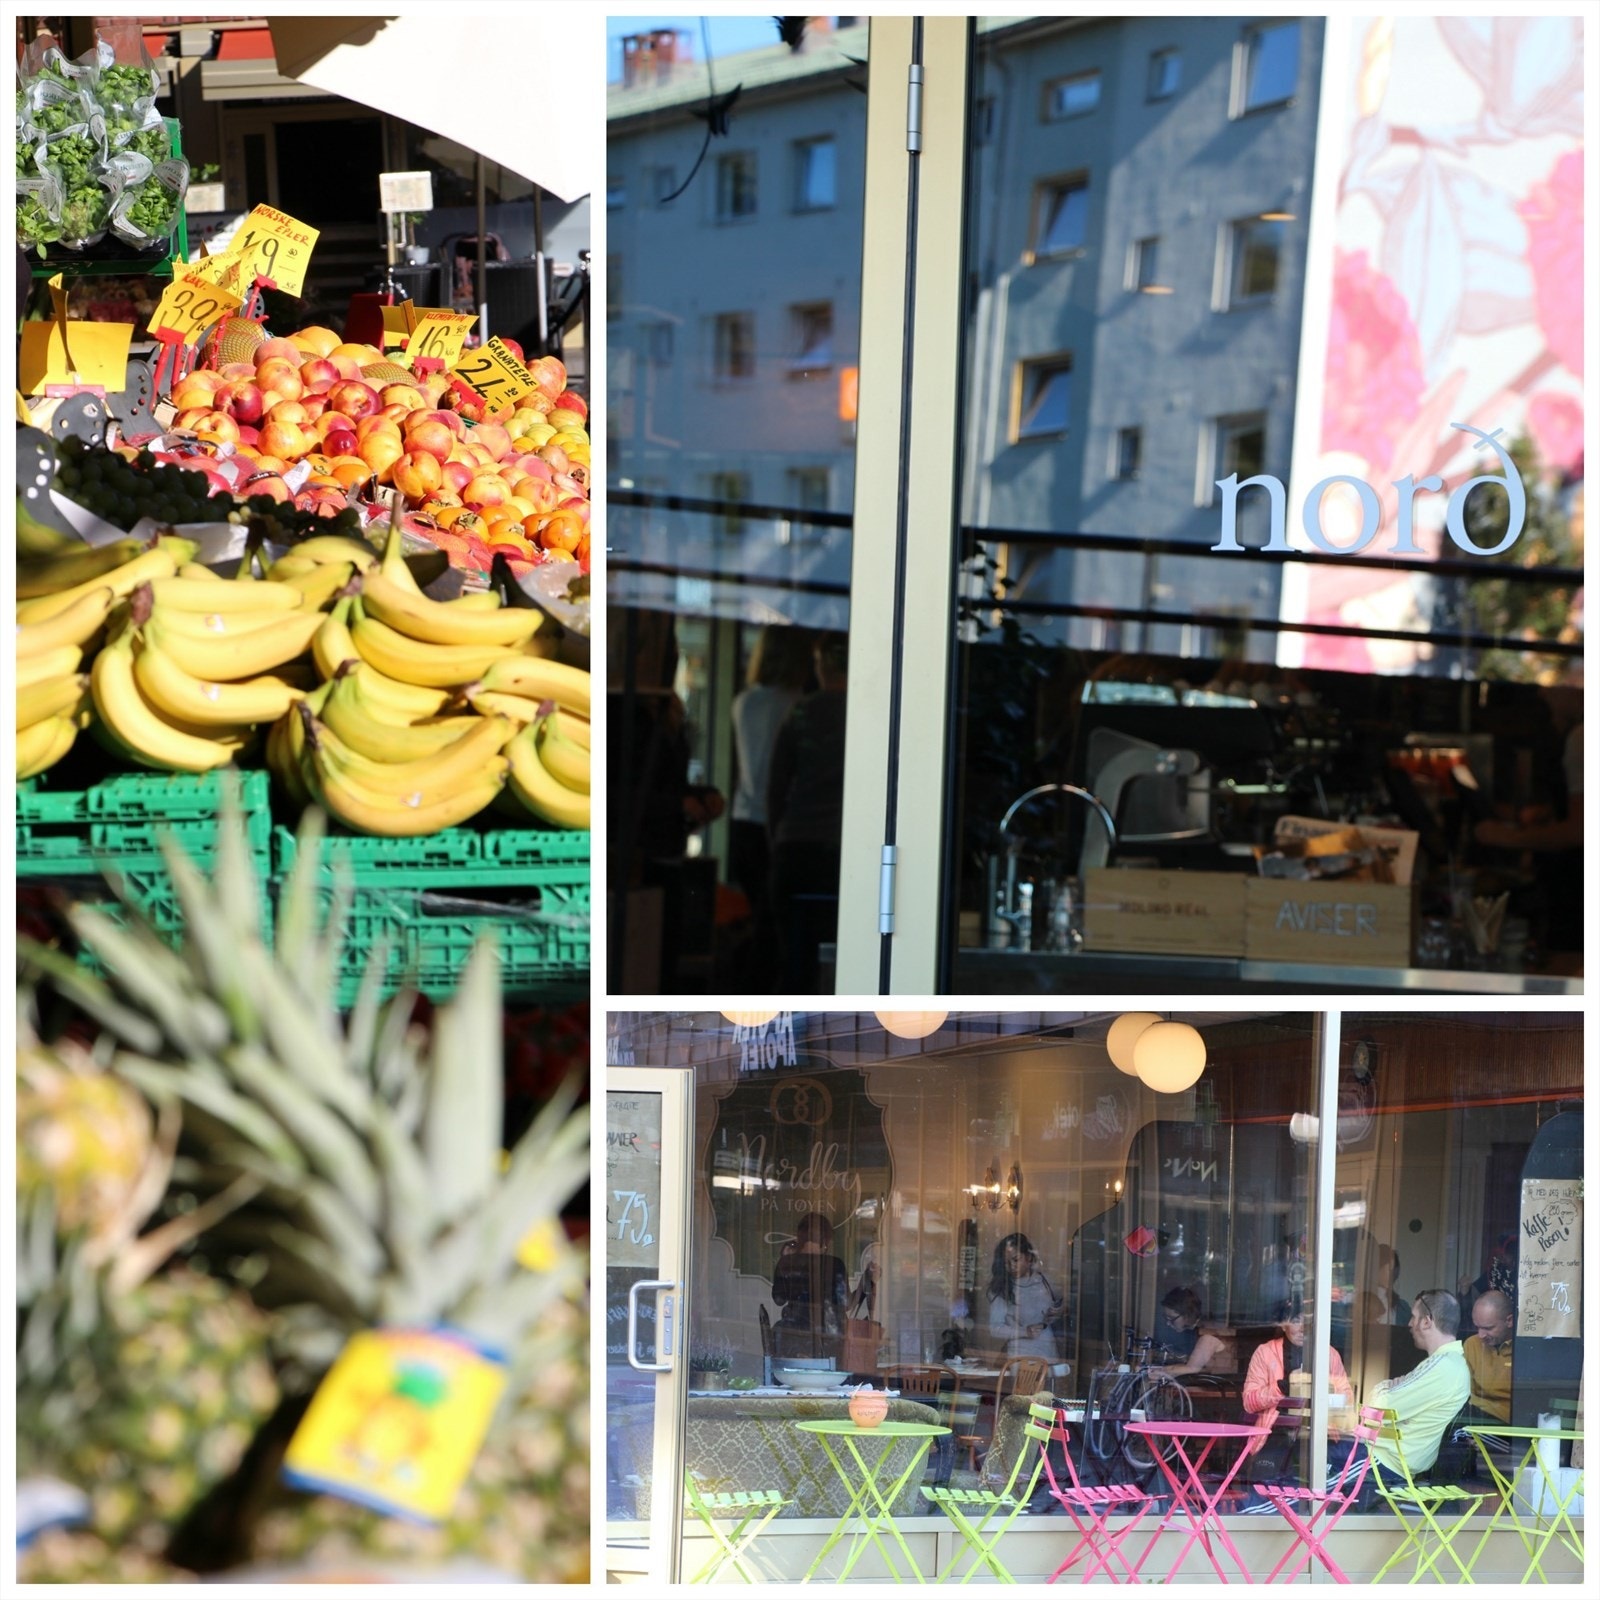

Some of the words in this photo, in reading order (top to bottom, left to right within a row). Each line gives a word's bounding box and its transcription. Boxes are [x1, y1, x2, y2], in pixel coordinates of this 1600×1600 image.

[252, 205, 294, 228] NORSKE
[274, 225, 309, 247] EPLER
[243, 230, 279, 278] 19
[418, 325, 451, 358] 16
[487, 338, 538, 388] GRANATEPLE
[1275, 900, 1377, 937] AVISER
[737, 1132, 862, 1226] Nordby
[760, 1196, 779, 1212] PÅ
[787, 1197, 837, 1213] TØYEN
[1522, 1213, 1552, 1238] Kaffe
